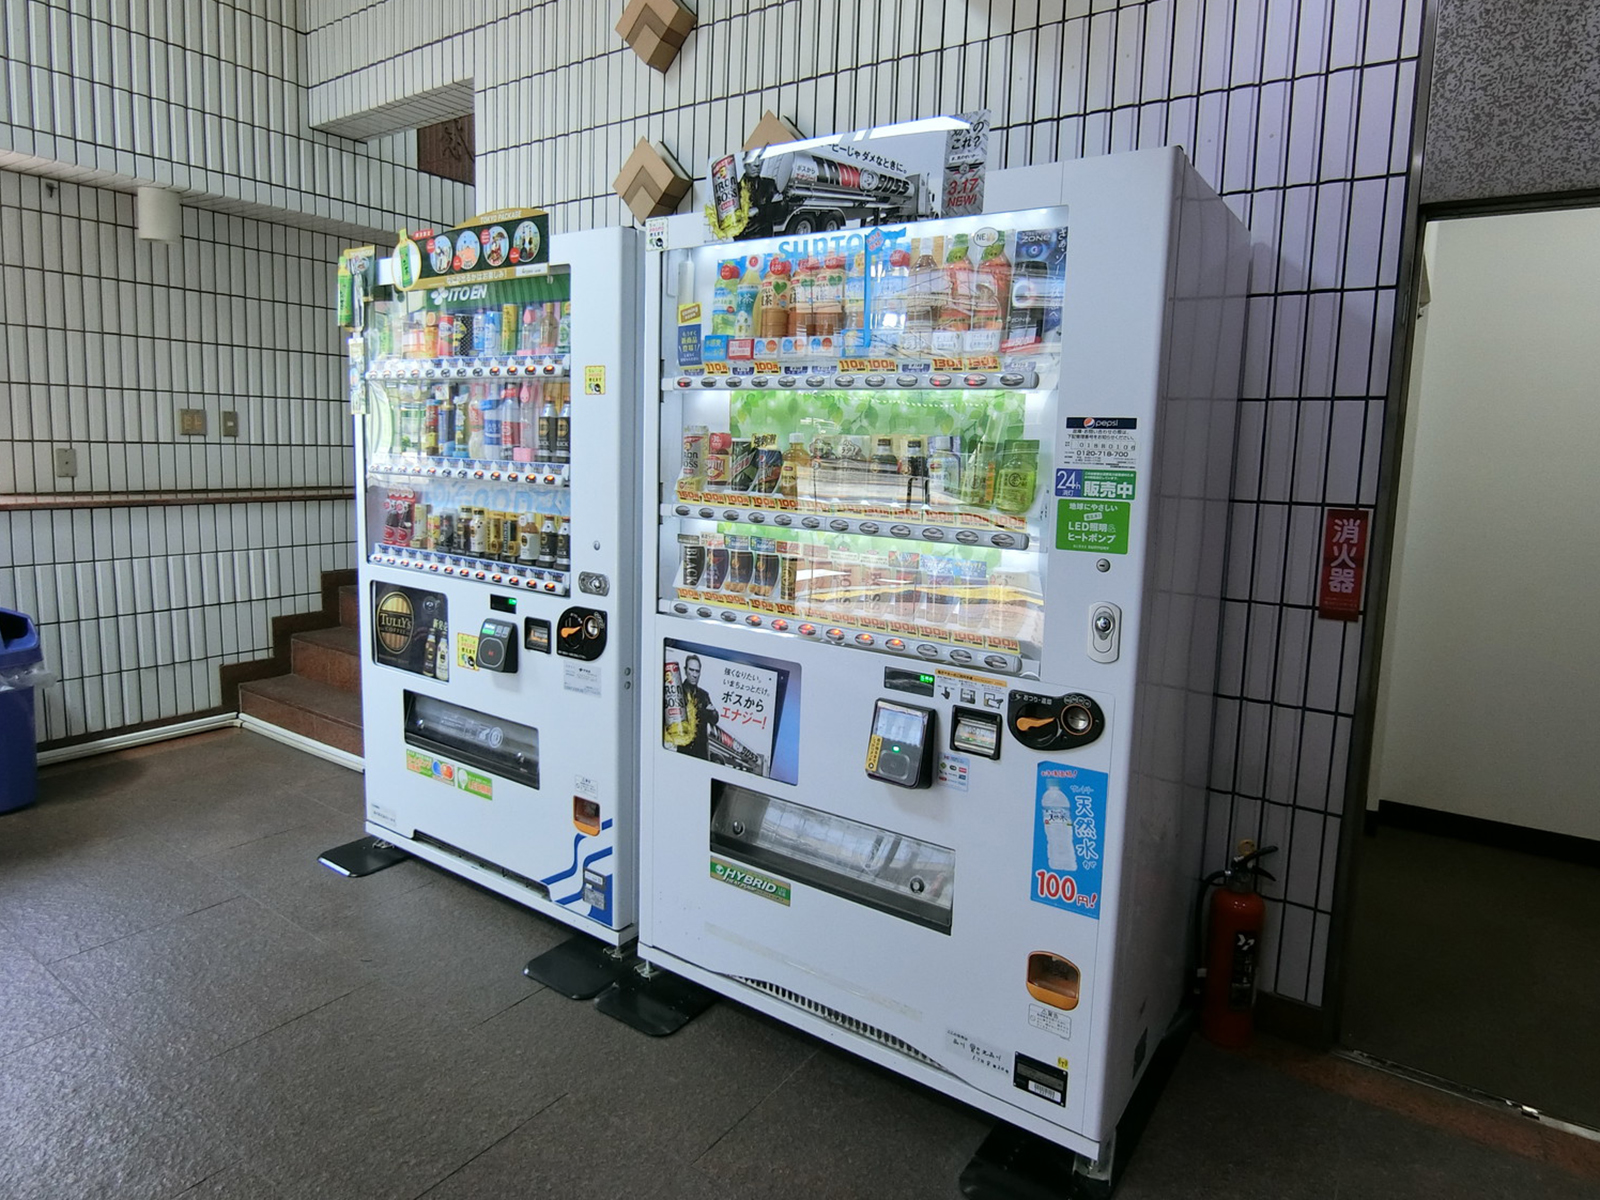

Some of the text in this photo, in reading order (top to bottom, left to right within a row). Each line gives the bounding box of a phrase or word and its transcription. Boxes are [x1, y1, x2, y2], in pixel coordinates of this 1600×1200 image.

[877, 172, 911, 196] BOSS
[946, 177, 979, 196] 3.17
[946, 193, 978, 208] NEW!
[447, 283, 488, 302] ITO EN
[705, 362, 729, 373] 110円
[754, 361, 780, 373] 100円
[867, 359, 897, 370] 100円
[1095, 419, 1119, 428] pepsi
[1076, 450, 1128, 458] 0120-718-700
[1083, 480, 1134, 499] 販売中
[701, 492, 725, 502] 100円
[726, 494, 750, 504] 100円
[752, 496, 776, 507] 100円
[1068, 501, 1119, 512] 地球にやさしい
[1067, 521, 1117, 534] LED照明&
[1067, 532, 1117, 544] ヒートポンプ
[1328, 517, 1361, 594] 消火器
[685, 545, 698, 587] BLACK
[677, 588, 700, 599] 100円
[701, 591, 724, 602] 100円
[723, 594, 747, 604] 100円
[749, 598, 774, 611] 100円
[859, 615, 887, 627] 100円
[889, 621, 917, 633] 100円
[919, 625, 949, 638] 100円
[986, 635, 1019, 649] 100円
[724, 667, 762, 684] 強くなりたい。
[722, 678, 770, 698] いまちょっとだけ。
[721, 690, 765, 713] ボスから
[720, 706, 767, 730] エナジー!
[722, 867, 777, 894] HYBRID
